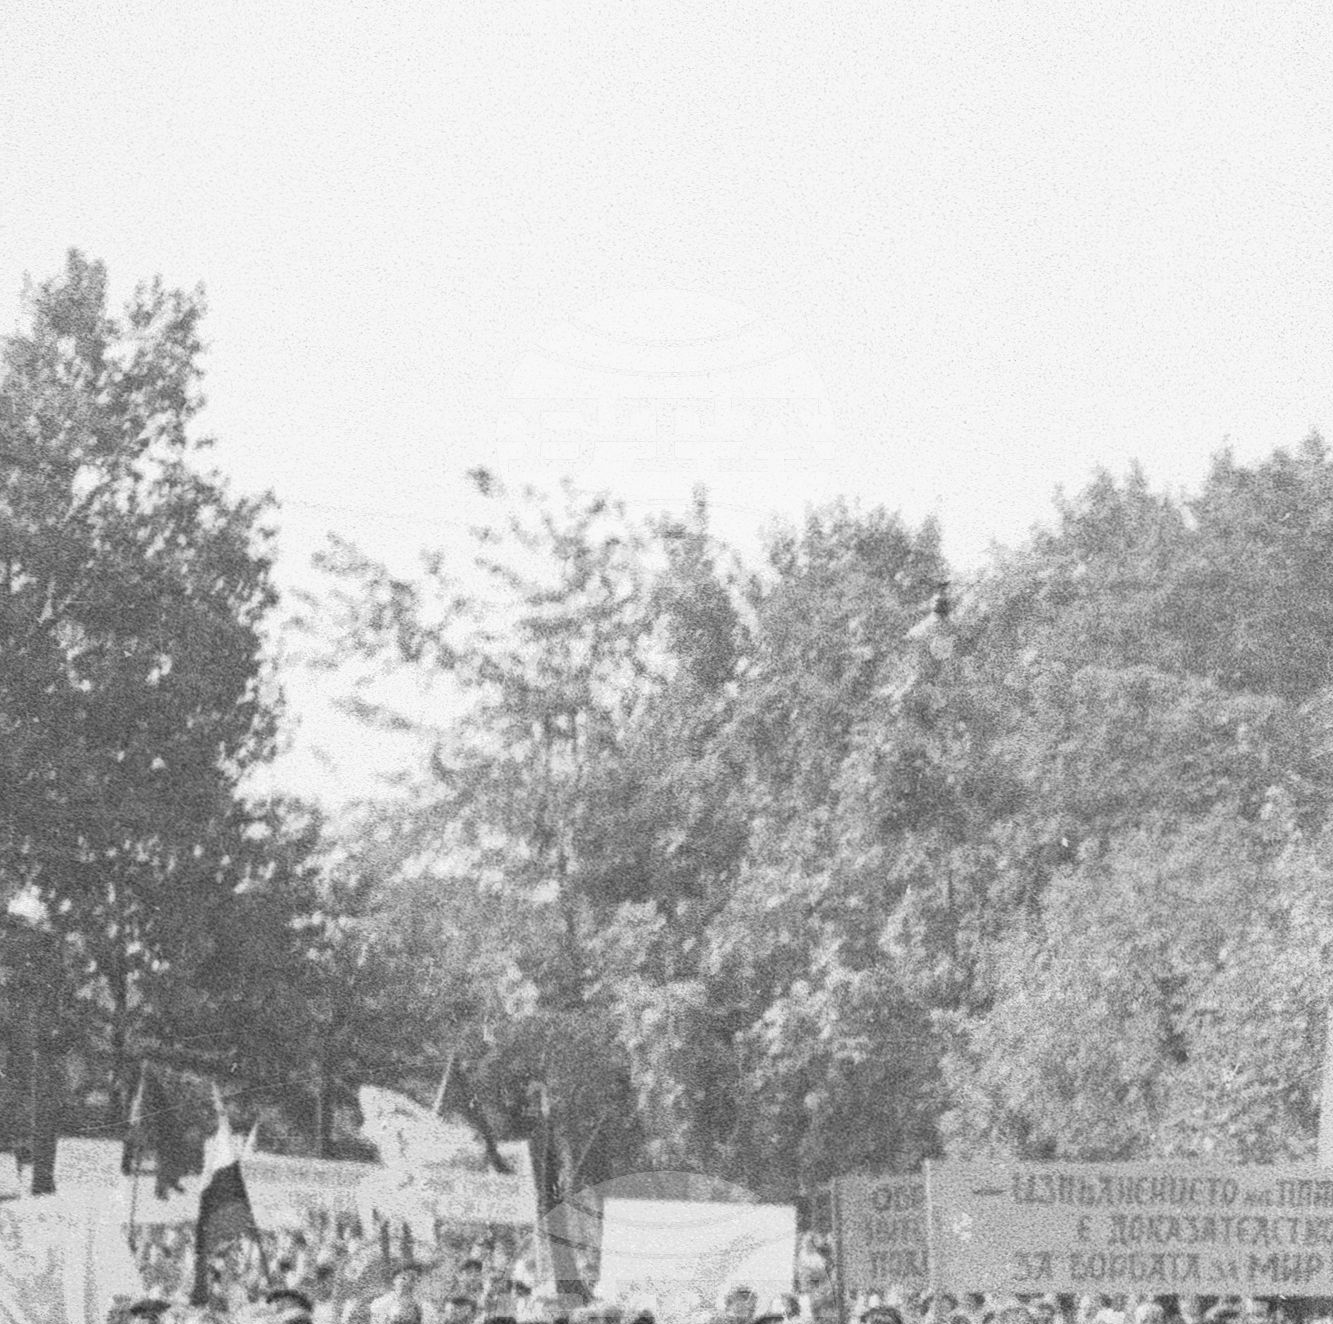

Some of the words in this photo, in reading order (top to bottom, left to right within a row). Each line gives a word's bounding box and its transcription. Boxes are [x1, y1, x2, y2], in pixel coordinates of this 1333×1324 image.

[1077, 1214, 1092, 1244] Е
[1011, 1250, 1053, 1281] ЗА
[1069, 1252, 1201, 1282] БОРБАТА
